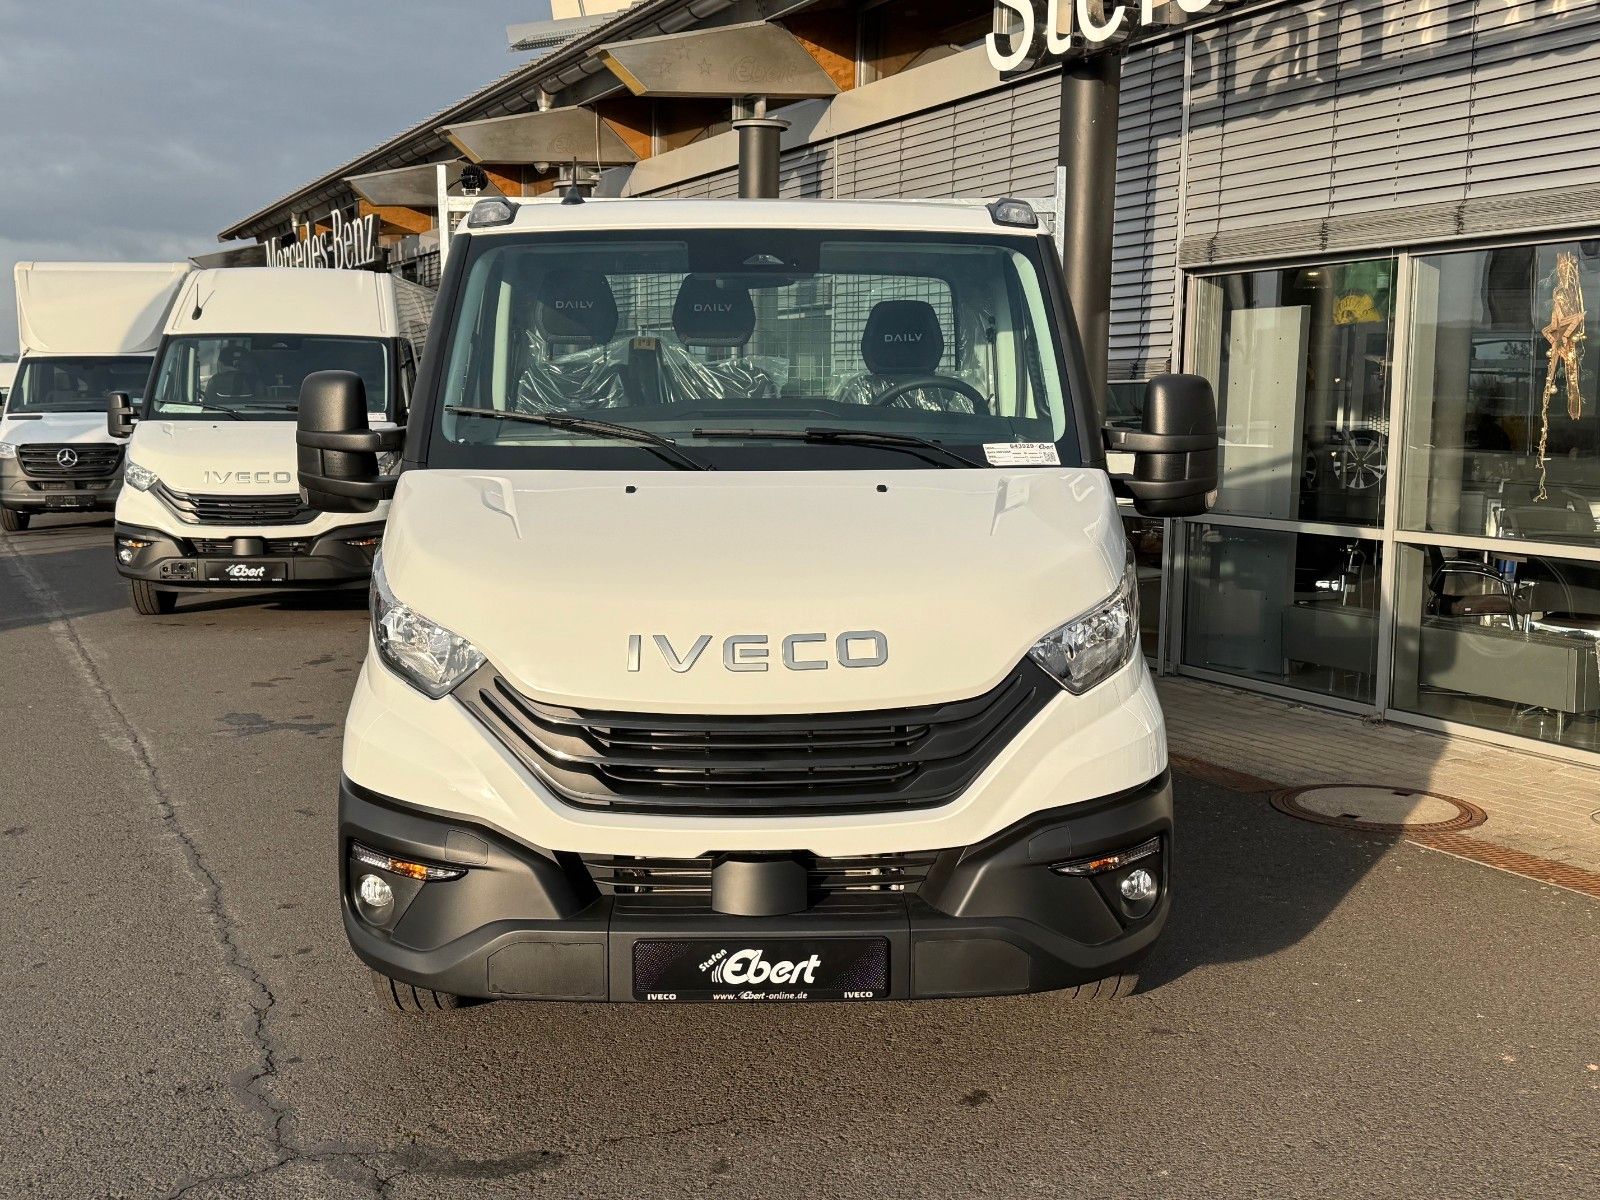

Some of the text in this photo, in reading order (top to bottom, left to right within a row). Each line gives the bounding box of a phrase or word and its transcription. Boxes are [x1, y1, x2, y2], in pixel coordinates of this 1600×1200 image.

[265, 208, 375, 269] Mercedes-Benz
[555, 300, 594, 309] DAILY
[693, 303, 733, 312] DAILY
[884, 333, 923, 342] DAILY
[203, 470, 291, 484] IVECO
[231, 564, 266, 577] Ebert
[626, 630, 889, 673] IVECO
[698, 948, 822, 985] Stefan Ebert
[647, 993, 677, 1001] IVECO
[843, 991, 874, 999] IVECO
